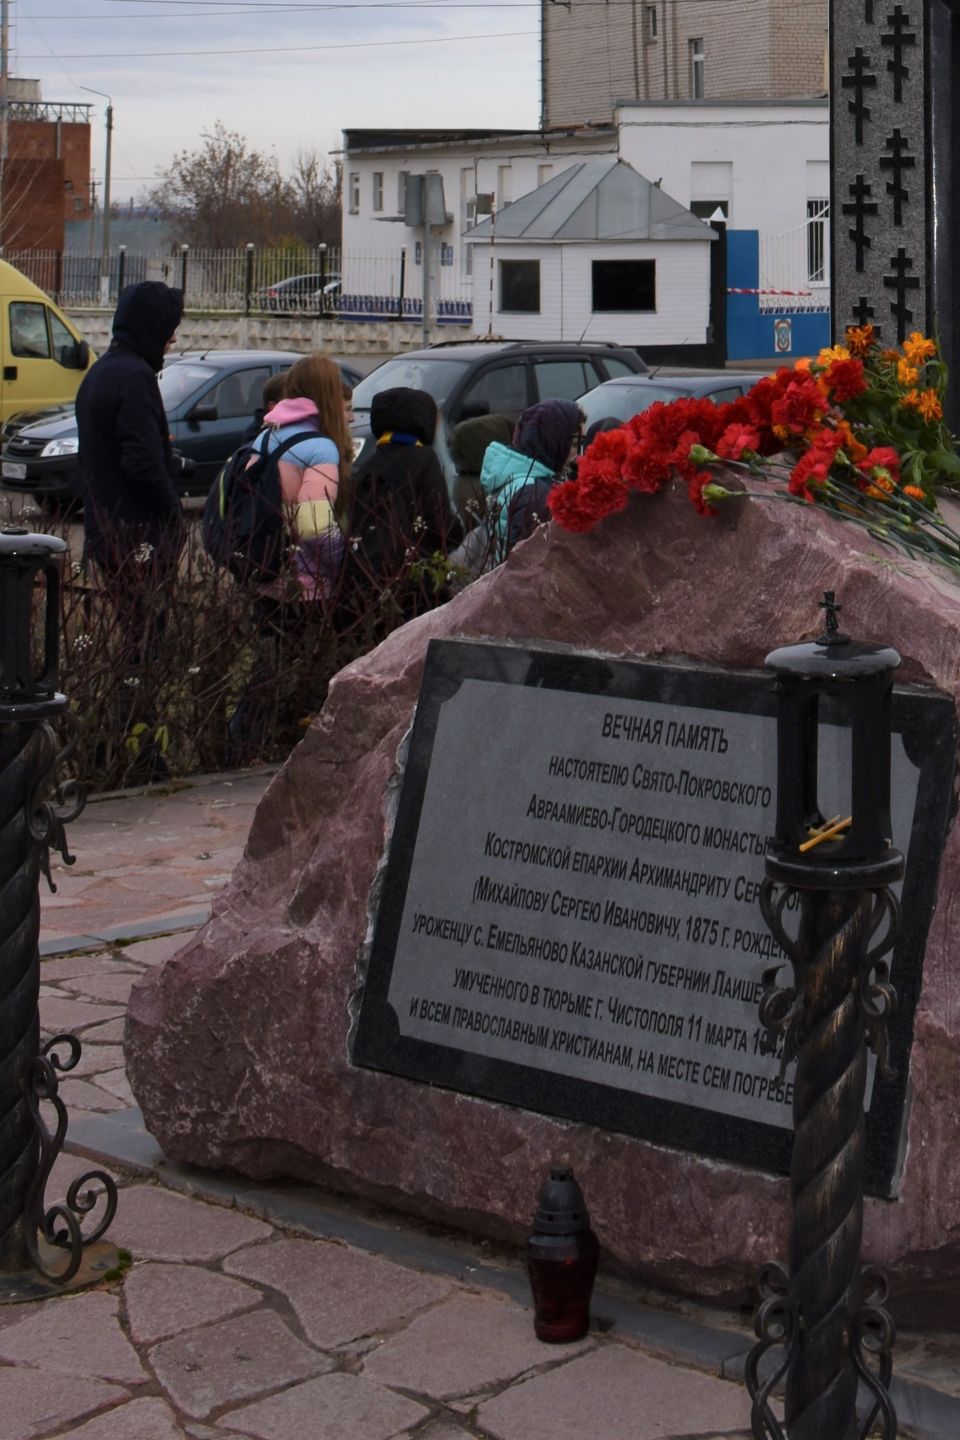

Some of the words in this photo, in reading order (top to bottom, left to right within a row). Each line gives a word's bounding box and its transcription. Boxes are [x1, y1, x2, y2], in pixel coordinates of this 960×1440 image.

[602, 713, 663, 745] ВЕЧНАЯ
[665, 722, 729, 754] ПАМЯТЬ
[548, 756, 628, 786] НАСТОЯТЕЛЮ
[632, 763, 771, 809] СВЯТО-ПОКРОВСКОГО
[527, 793, 700, 846] АВРААМИЕВО-ГОРОДЕЦКОГО
[484, 832, 571, 869] КОСТРОМСКОЙ
[572, 852, 628, 880] ЕПАРХИИ
[629, 858, 731, 898] АРХИМАНДРИТУ
[472, 876, 549, 913] (МИХАЙЛОВУ
[551, 890, 601, 924] СЕРГЕЮ
[603, 900, 681, 942] ИВАНОВИЧУ,
[685, 915, 719, 946] 1875
[720, 927, 730, 948] Г.
[412, 913, 473, 947] УРОЖЕНЦУ
[474, 927, 484, 948] С.
[487, 924, 568, 964] ЕМЕЛЬЯНОВО
[570, 941, 644, 981] КАЗАНСКОЙ
[645, 964, 711, 996] ГУБЕРНИИ
[409, 997, 419, 1018] И
[419, 1000, 452, 1025] ВСЕМ
[452, 1007, 549, 1048] ПРАВОСЛАВНЫМ
[550, 1029, 634, 1072] ХРИСТИАНАМ,
[637, 1050, 655, 1074] НА
[657, 1054, 700, 1084] МЕСТЕ
[703, 1065, 730, 1090] СЕМ
[453, 968, 529, 1002] УМУЧЕННОГО
[530, 984, 540, 1005] В
[543, 987, 594, 1018] ТЮРЬМЕ
[594, 999, 604, 1020] Г.
[608, 997, 684, 1038] ЧИСТОПОЛЯ
[688, 1015, 703, 1041] 11
[704, 1023, 748, 1053] МАРТА
